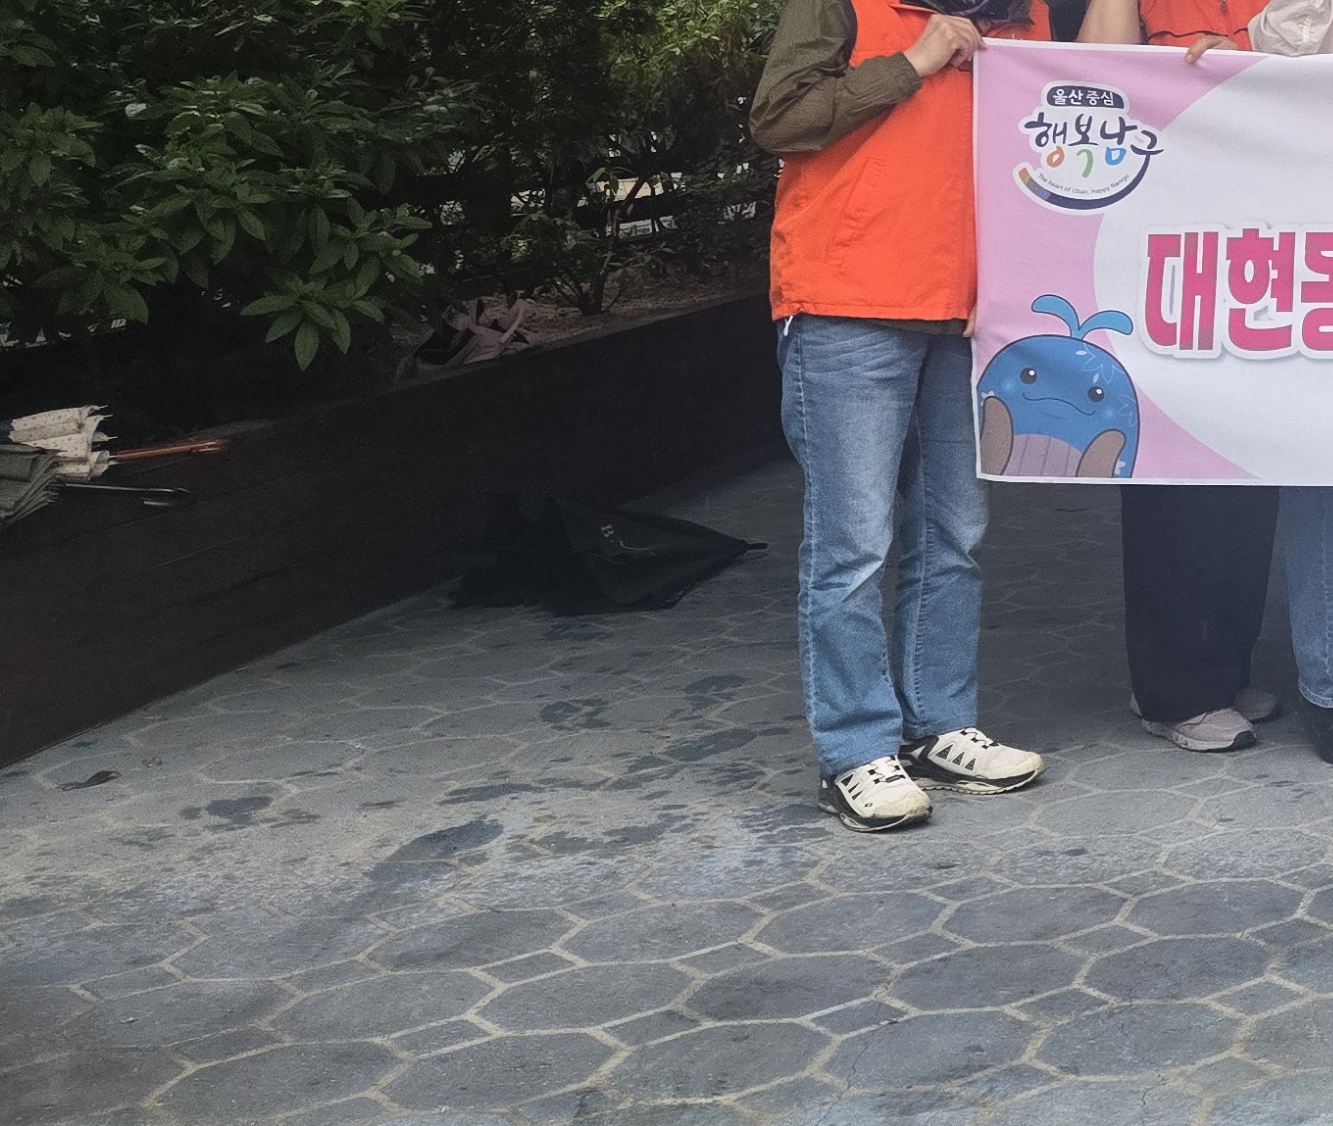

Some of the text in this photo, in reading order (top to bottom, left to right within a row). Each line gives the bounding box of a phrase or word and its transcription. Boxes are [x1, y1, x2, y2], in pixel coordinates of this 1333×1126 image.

[1052, 88, 1114, 106] 울산 중심
[1024, 112, 1164, 178] 행복남구
